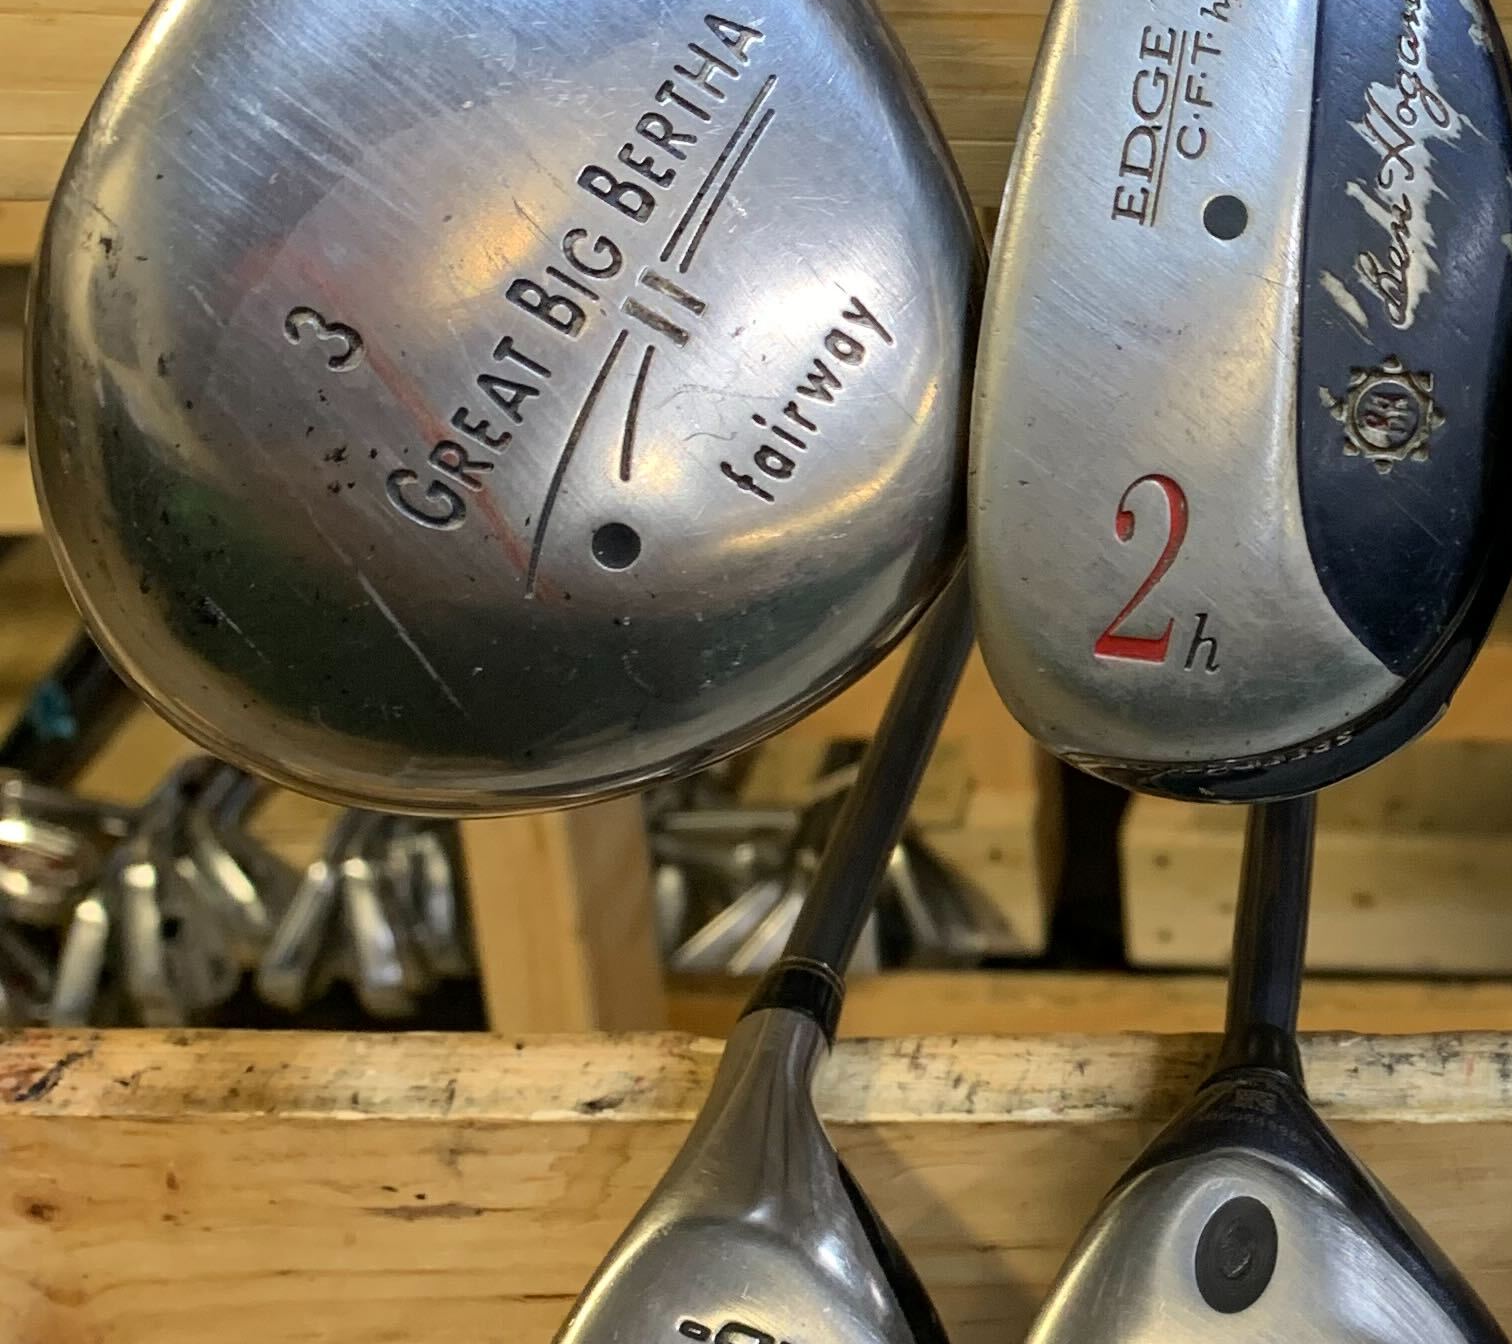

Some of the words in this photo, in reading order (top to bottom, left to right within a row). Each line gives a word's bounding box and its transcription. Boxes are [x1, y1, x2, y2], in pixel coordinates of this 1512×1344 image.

[1112, 25, 1177, 226] EDGE
[284, 306, 365, 373] 3
[385, 336, 552, 532] GREAT
[505, 227, 625, 338] BIG
[576, 13, 766, 224] BERTHA
[1357, 193, 1413, 328] Ben
[720, 295, 896, 503] fairway
